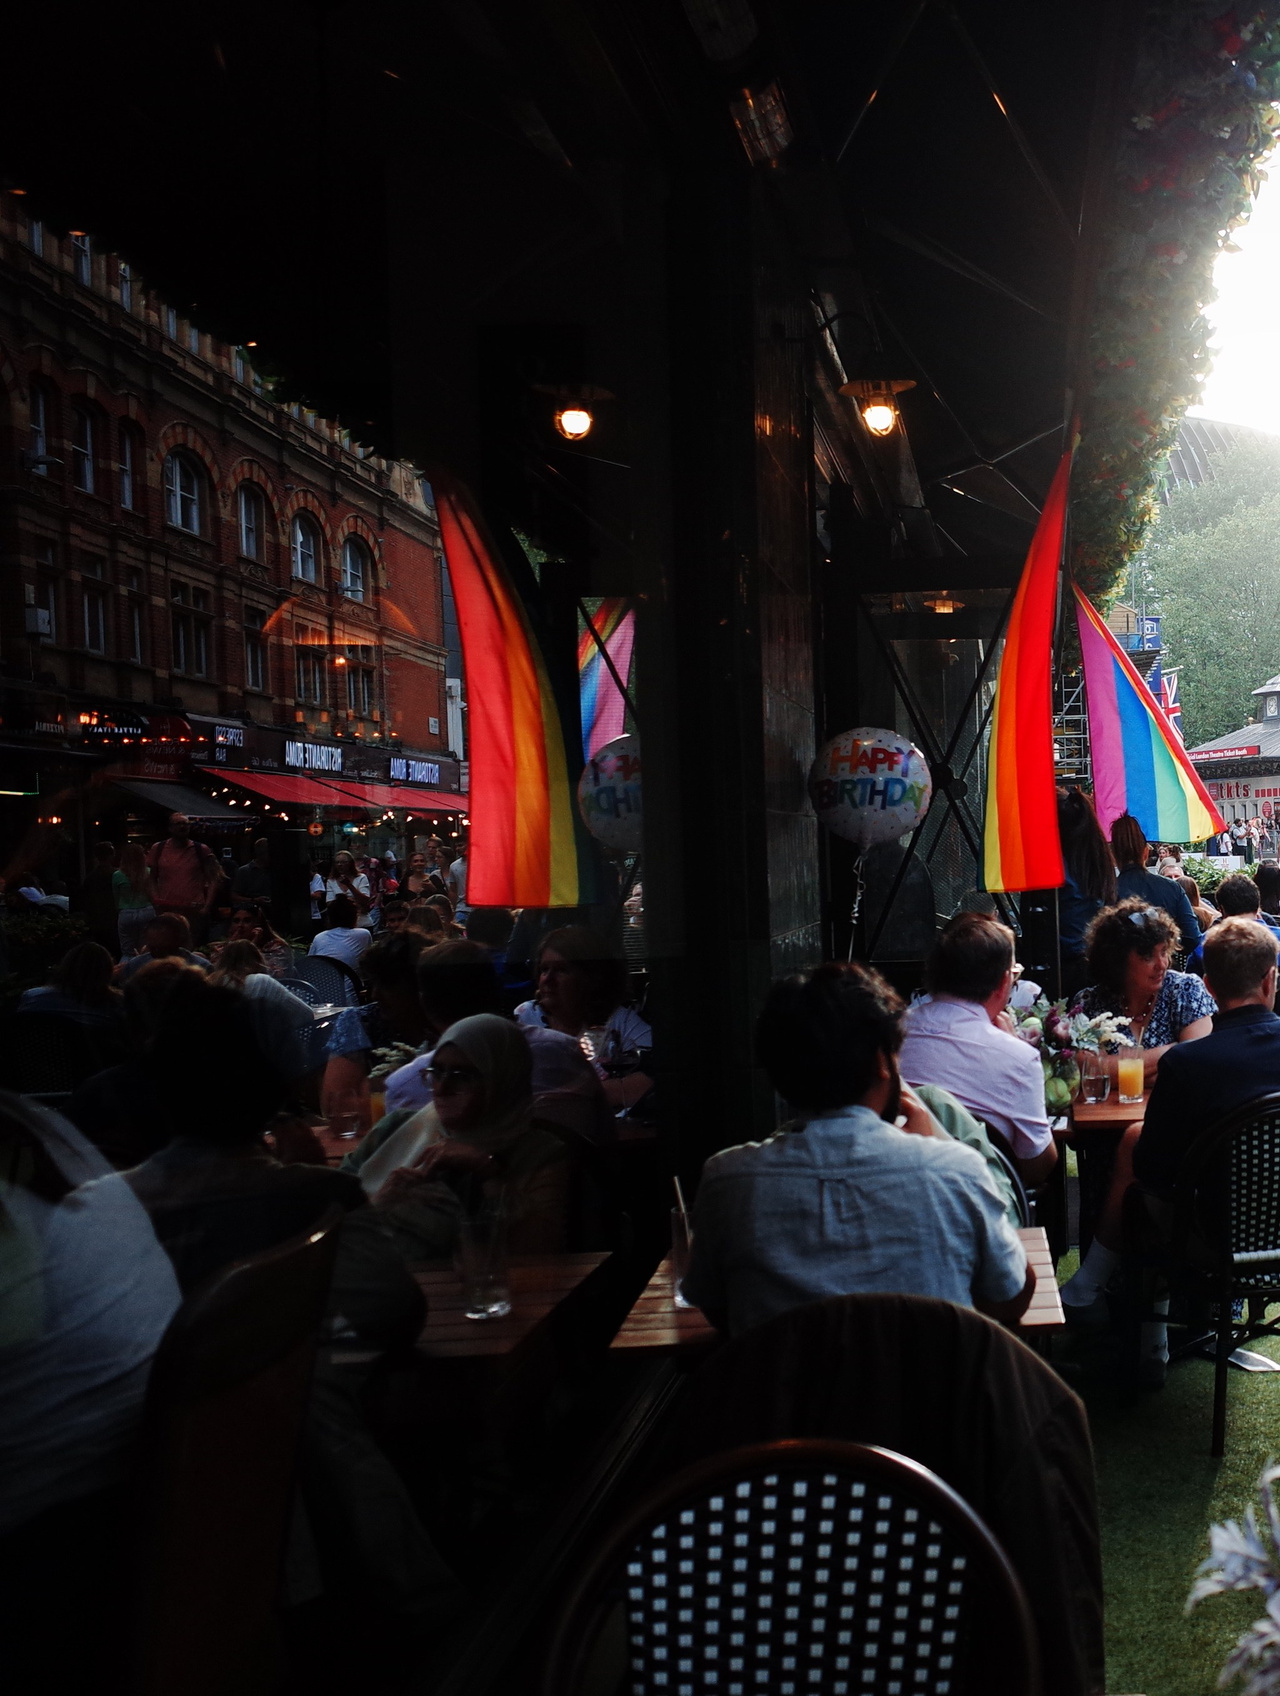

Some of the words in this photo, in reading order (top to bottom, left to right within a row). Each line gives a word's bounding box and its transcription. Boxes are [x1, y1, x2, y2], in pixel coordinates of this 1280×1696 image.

[828, 739, 916, 778] HAPPY
[816, 777, 928, 813] BIRTHDAY
[1220, 781, 1251, 800] tkts
